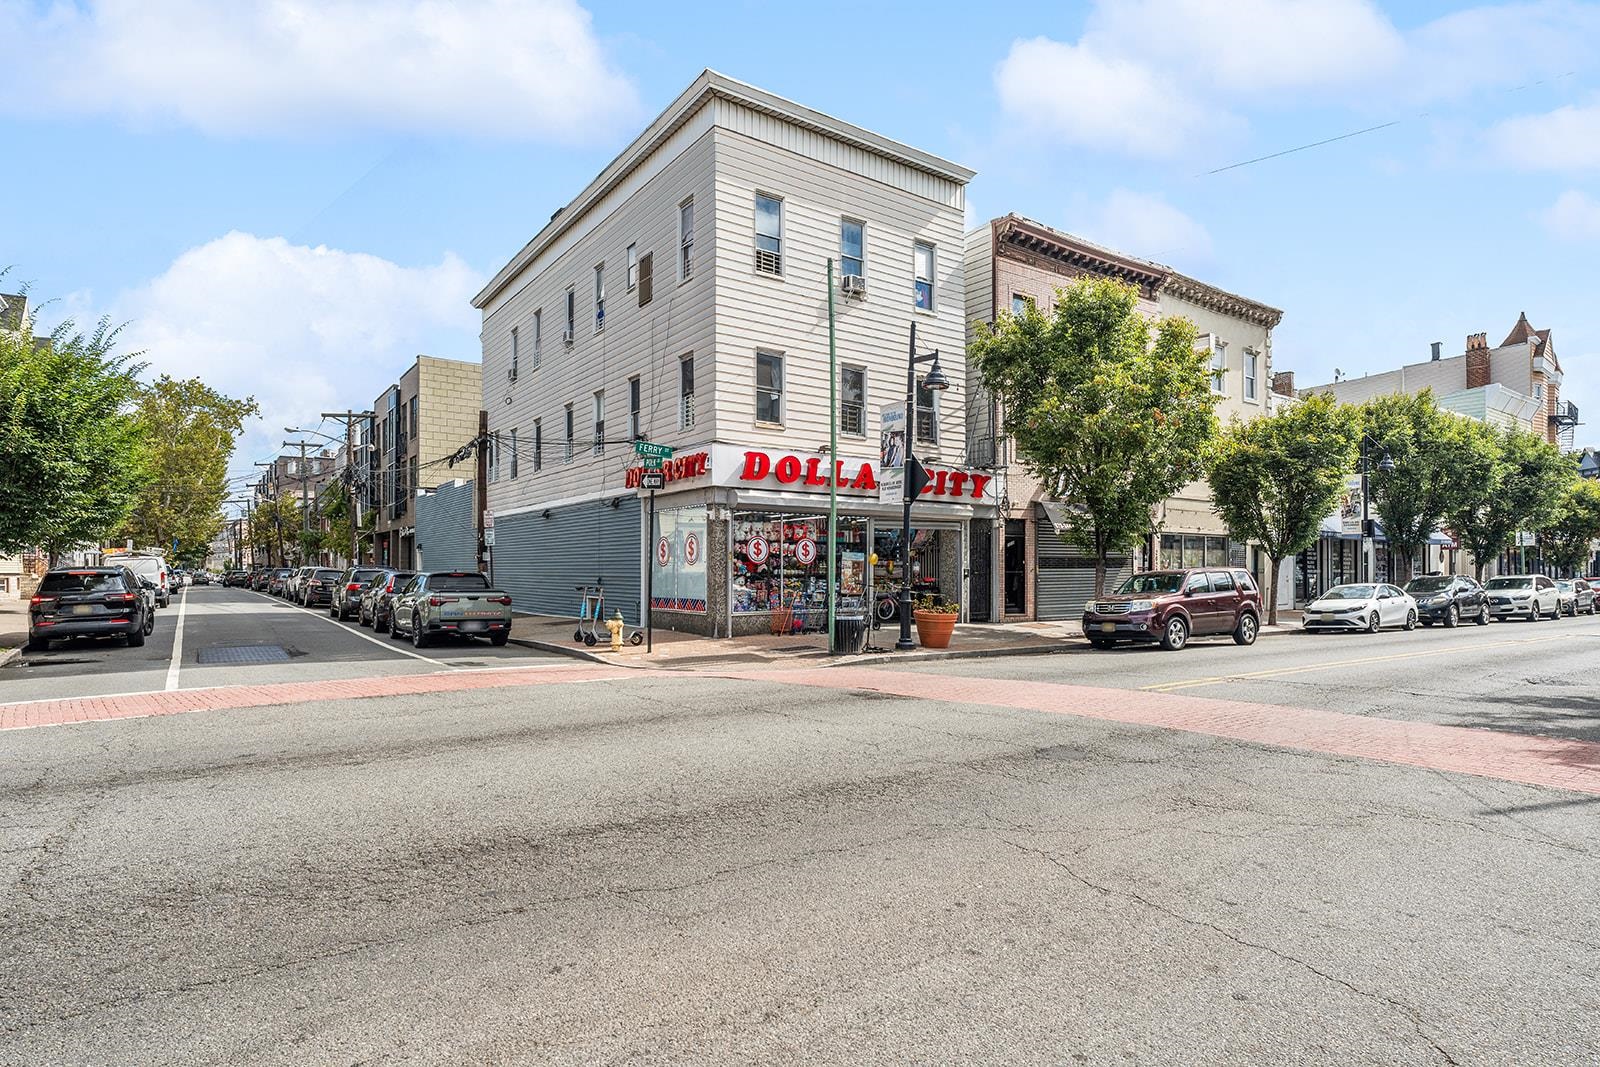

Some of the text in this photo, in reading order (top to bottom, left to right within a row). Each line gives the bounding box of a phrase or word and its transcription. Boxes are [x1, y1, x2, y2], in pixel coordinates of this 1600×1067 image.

[639, 443, 663, 455] FERRY
[645, 458, 657, 467] POLK
[739, 451, 880, 490] DOLLA
[660, 541, 666, 559] $
[688, 538, 695, 558] $
[753, 539, 762, 558] $
[801, 542, 810, 558] $
